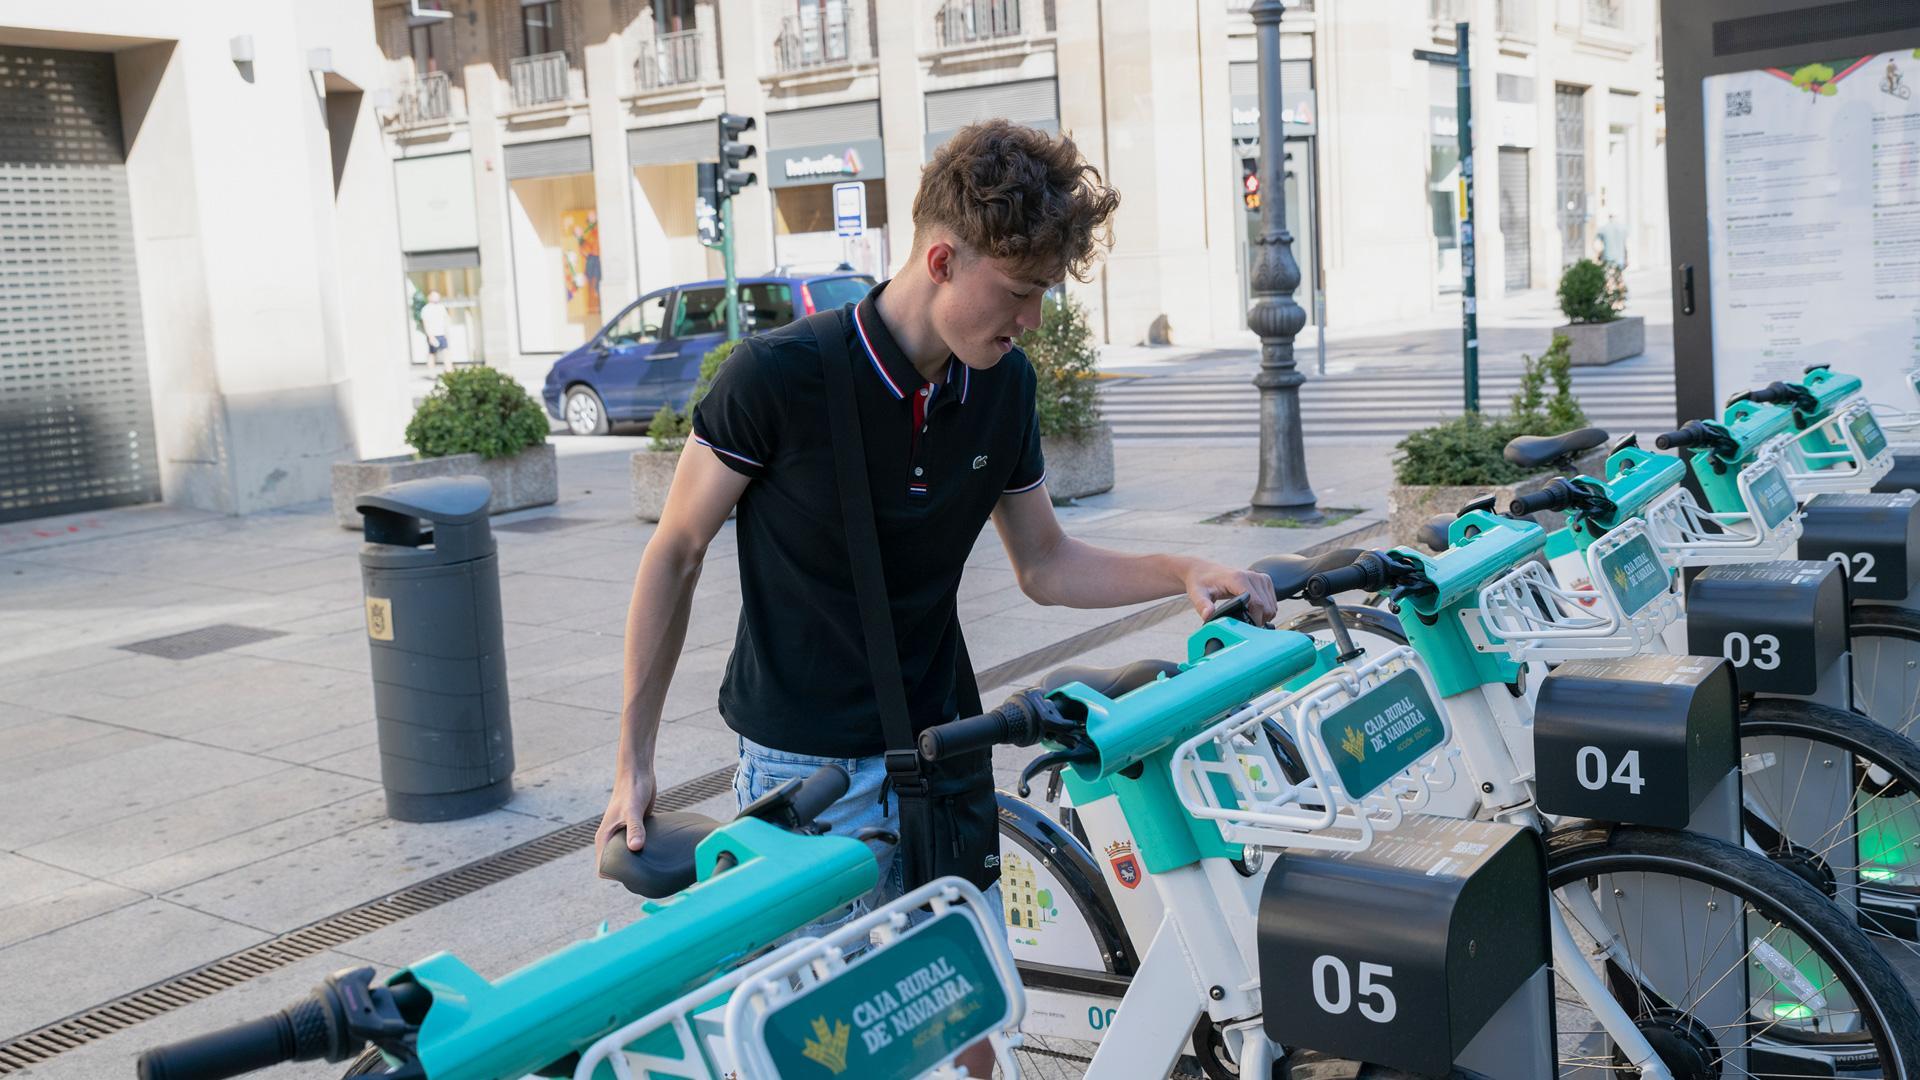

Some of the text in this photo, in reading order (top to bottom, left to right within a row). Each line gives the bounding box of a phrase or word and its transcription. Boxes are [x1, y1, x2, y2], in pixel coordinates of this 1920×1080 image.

[1827, 551, 1877, 583] 02
[1723, 631, 1781, 670] 03
[1364, 696, 1415, 736] CAJA RURAL
[1370, 708, 1426, 753] DE NAVARRA
[1576, 746, 1646, 795] 04
[852, 990, 900, 1029] CAJA
[894, 956, 956, 1004] RURAL
[1311, 954, 1397, 1024] 05
[861, 1021, 893, 1055] DE
[890, 974, 974, 1037] NAVARRA
